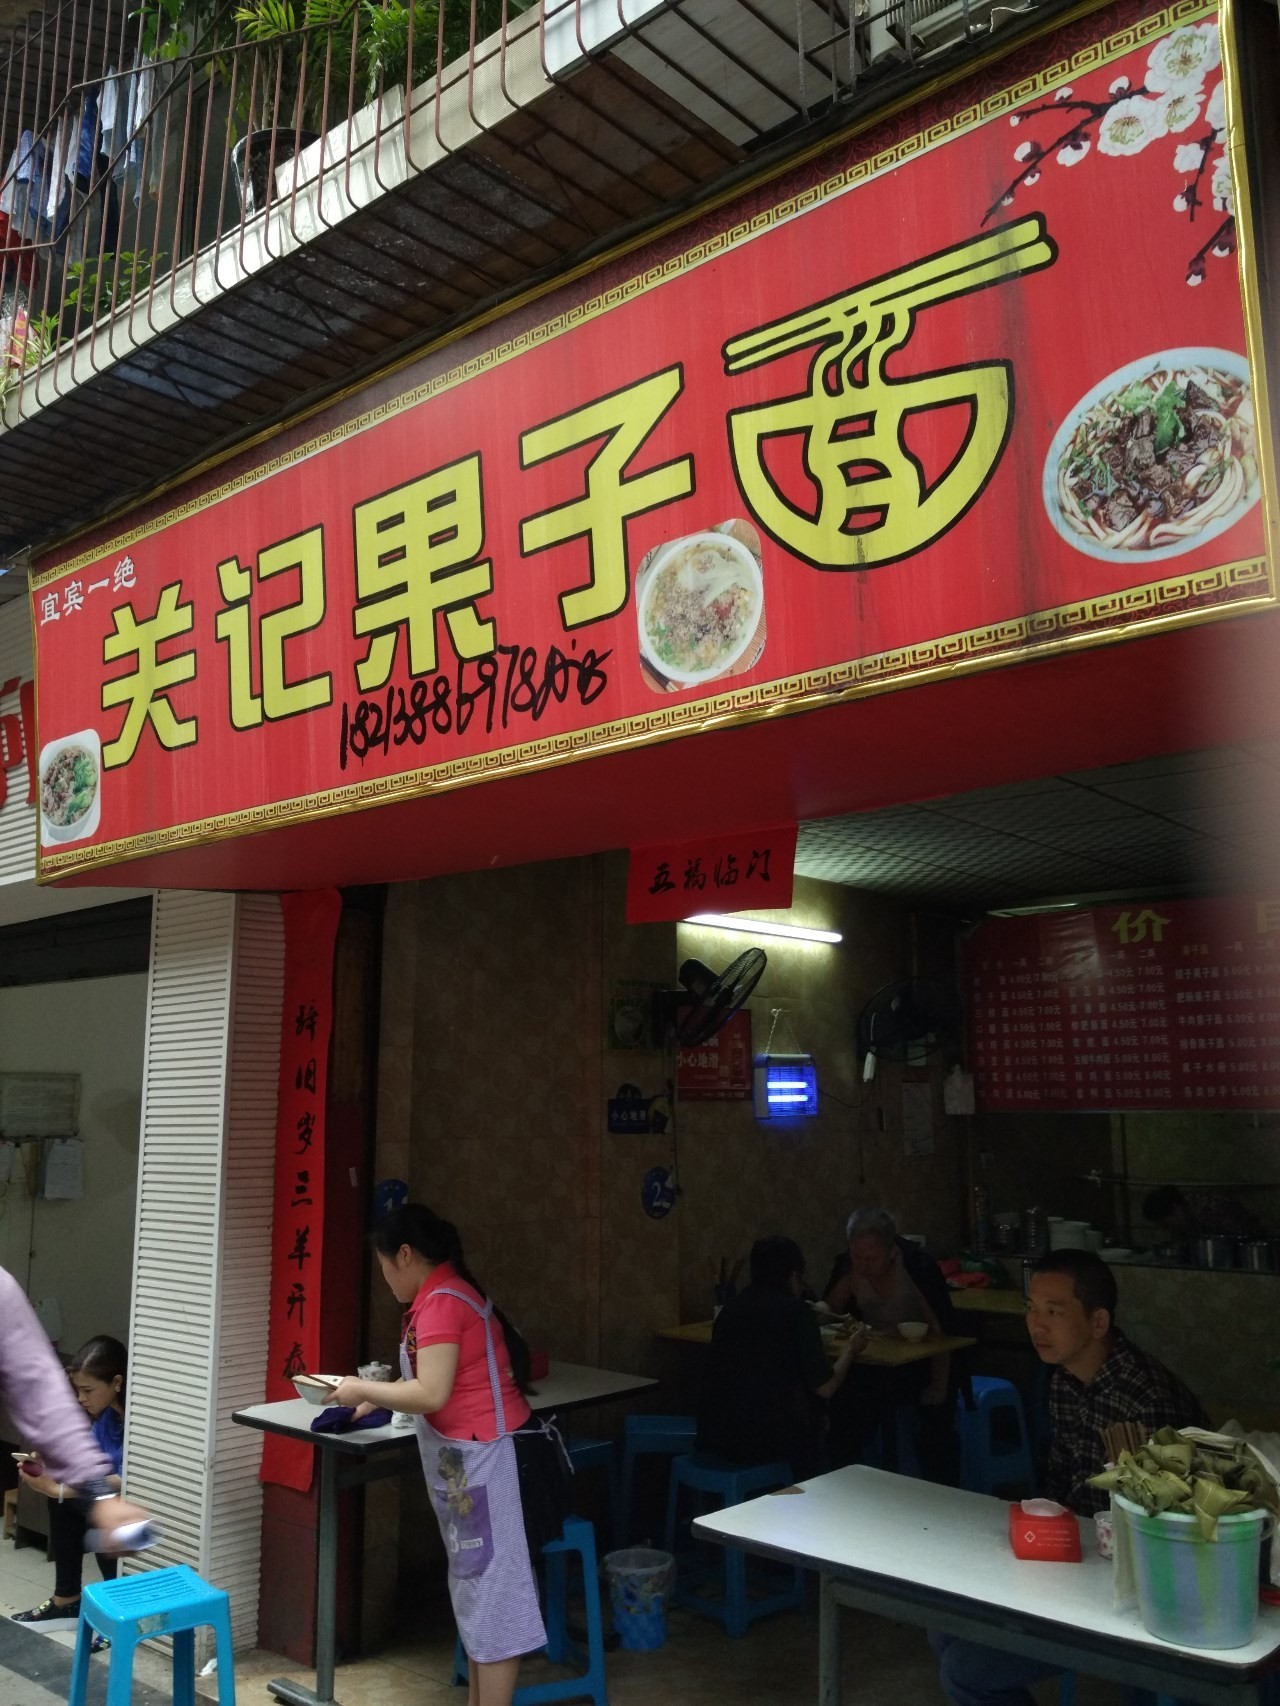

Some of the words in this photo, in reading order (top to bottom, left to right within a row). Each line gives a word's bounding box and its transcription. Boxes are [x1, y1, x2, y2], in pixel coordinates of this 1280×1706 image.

[39, 555, 137, 627] 宜宾一绝
[648, 849, 771, 894] 五福临门
[1111, 909, 1172, 945] 价
